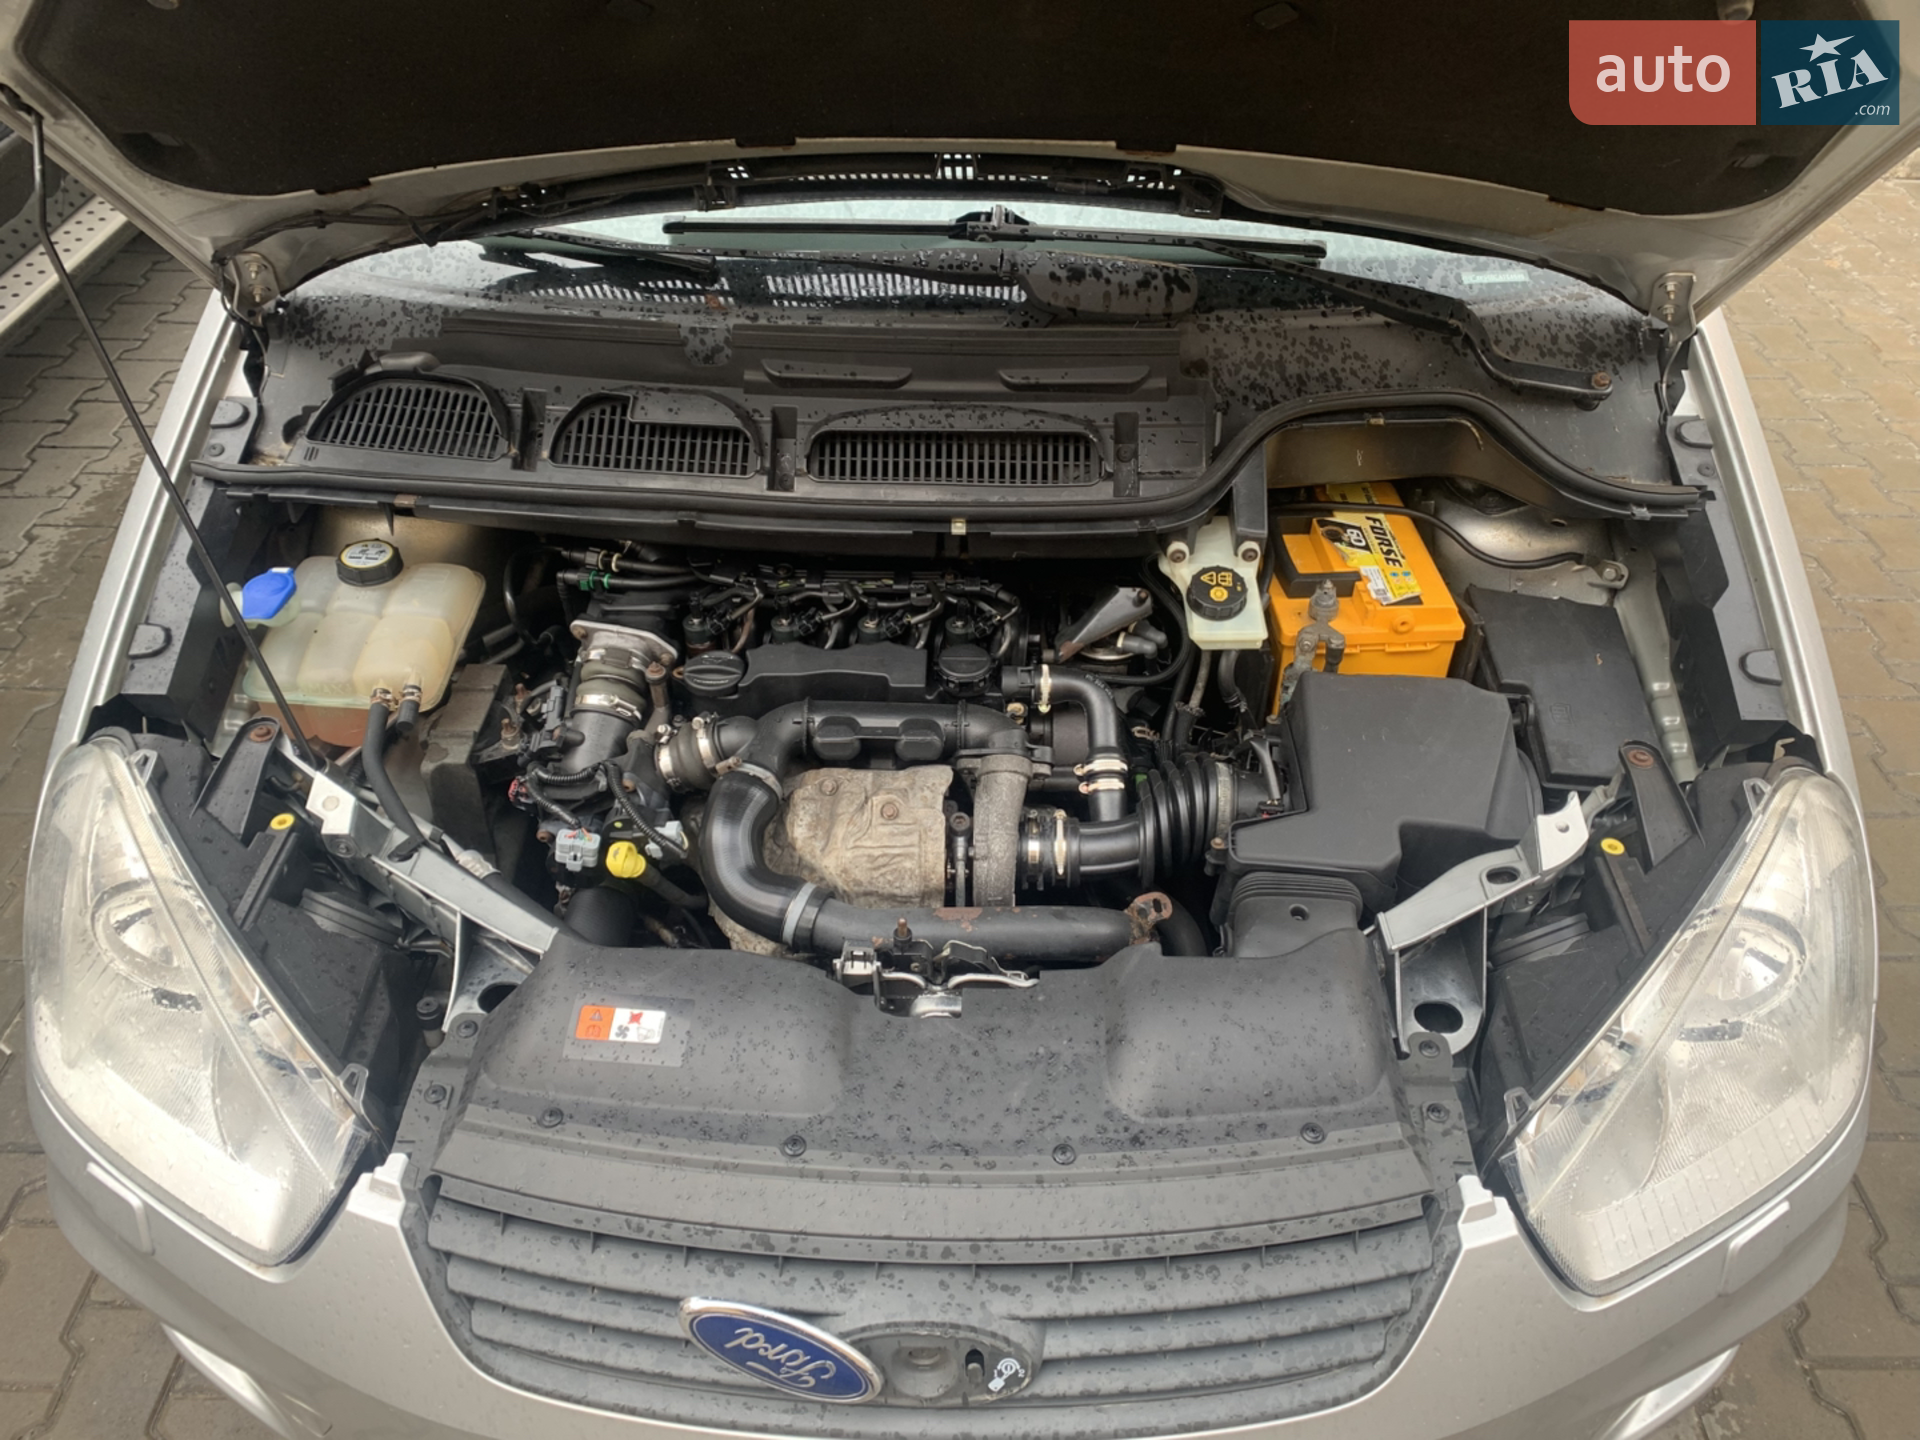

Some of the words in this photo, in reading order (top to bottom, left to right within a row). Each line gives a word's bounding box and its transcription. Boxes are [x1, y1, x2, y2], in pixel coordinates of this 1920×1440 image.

[1346, 528, 1366, 547] 60
[1364, 515, 1404, 568] FORSE
[724, 1327, 836, 1388] Ford
